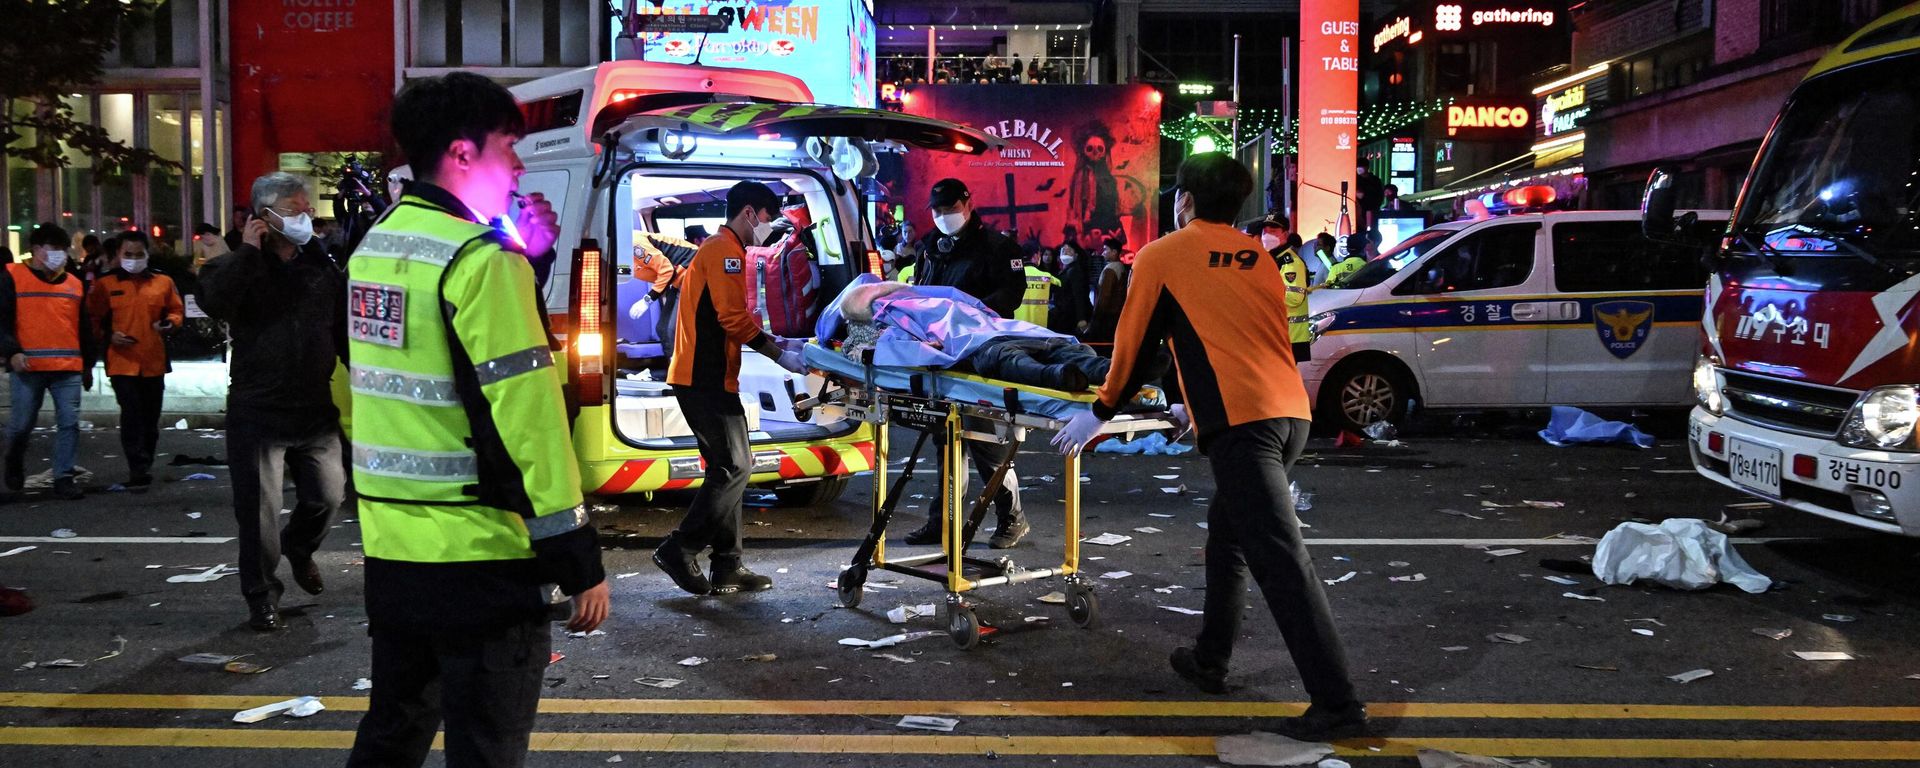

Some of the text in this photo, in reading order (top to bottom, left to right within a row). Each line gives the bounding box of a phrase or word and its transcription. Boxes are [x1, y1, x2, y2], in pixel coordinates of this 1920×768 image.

[284, 12, 353, 28] COFFEE
[1472, 8, 1553, 26] gathering
[1321, 21, 1359, 35] GUEST
[1374, 17, 1410, 53] gathering
[1340, 39, 1350, 53] &
[1322, 57, 1358, 71] TABLE
[1448, 106, 1529, 128] DANCO
[984, 119, 1063, 158] REBALL
[1000, 149, 1032, 158] WHISKY
[1208, 249, 1259, 270] 119
[1460, 304, 1502, 322] 경찰
[353, 320, 398, 340] POLICE
[1731, 452, 1778, 487] 78우4170
